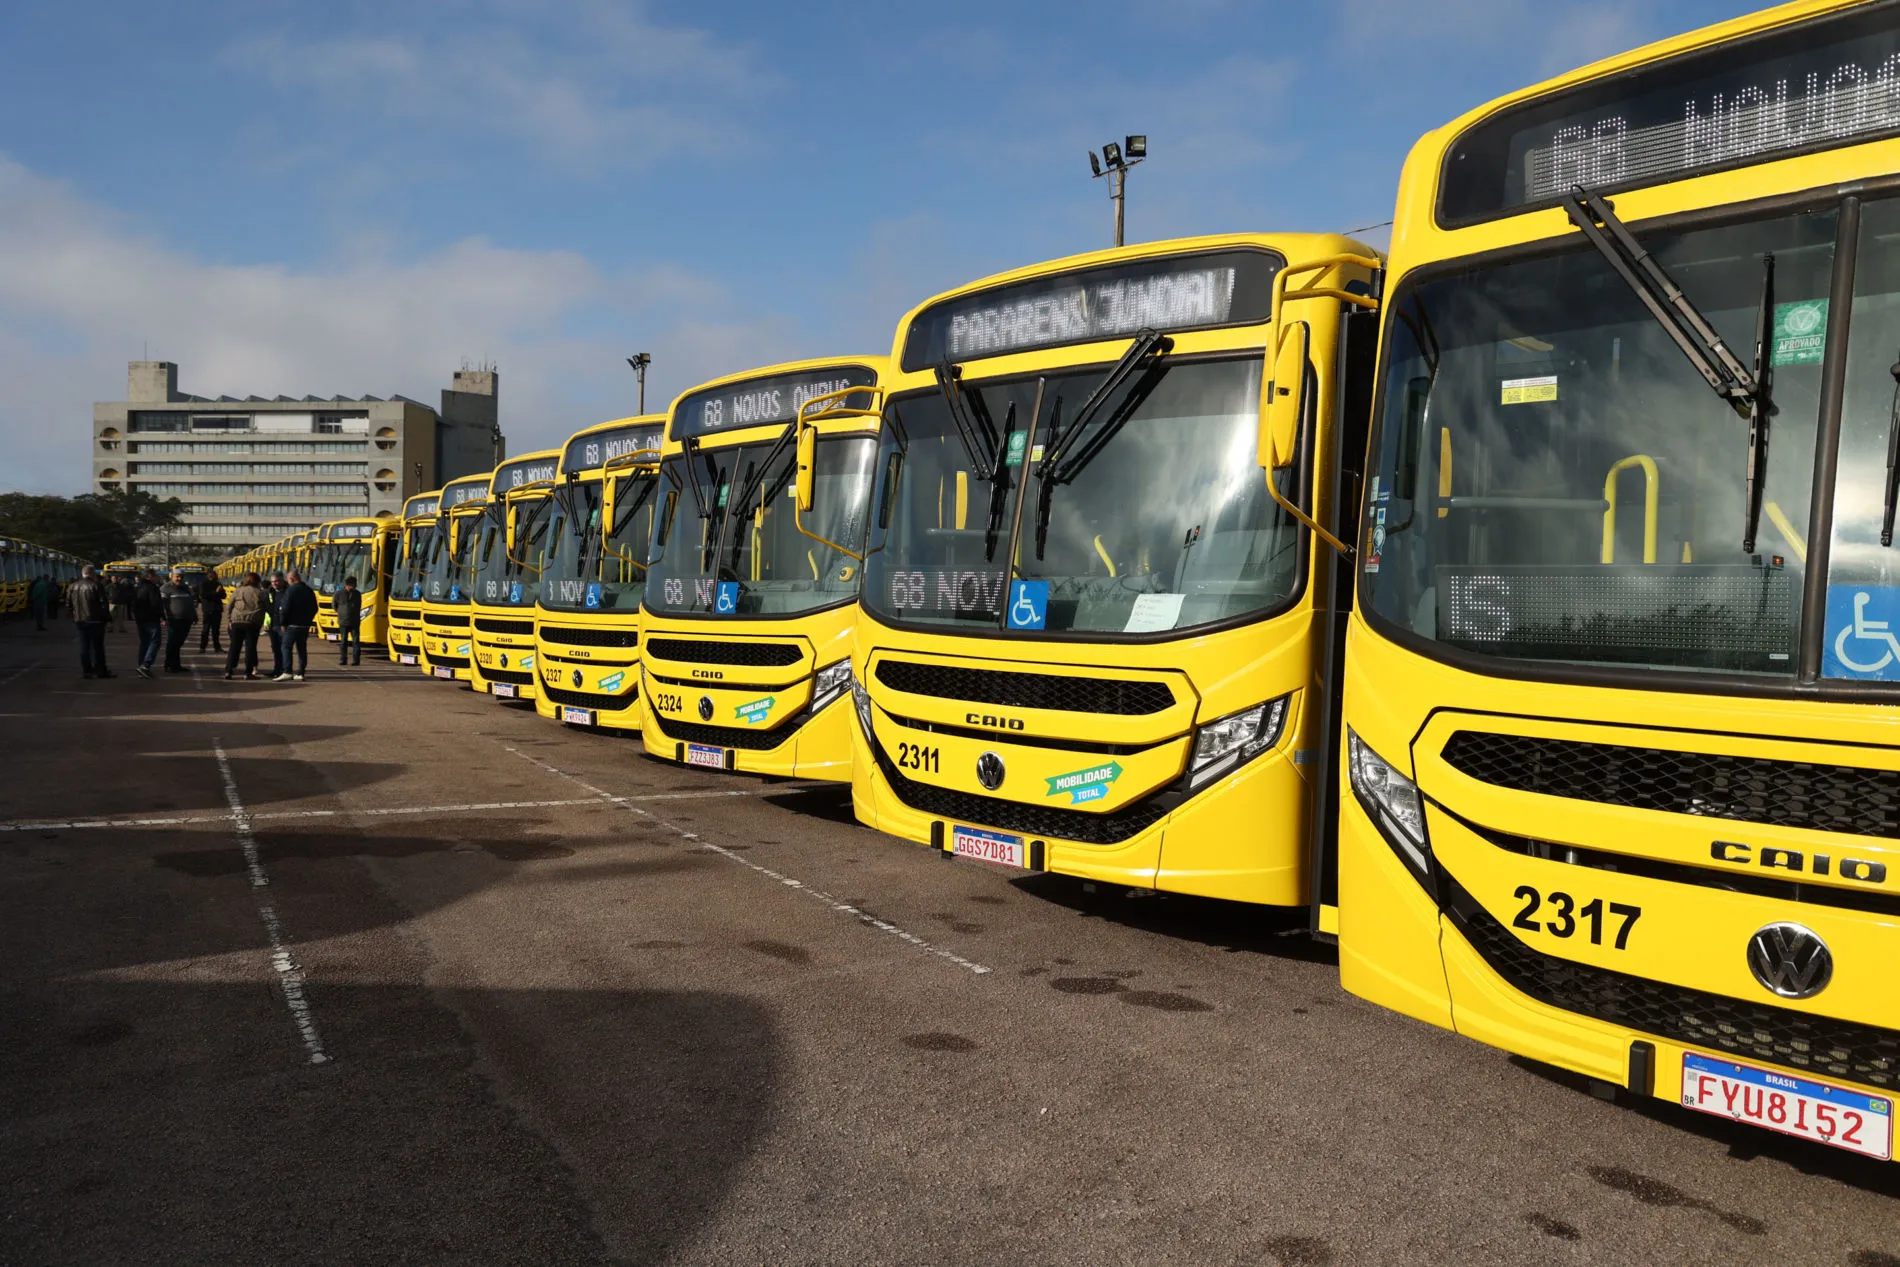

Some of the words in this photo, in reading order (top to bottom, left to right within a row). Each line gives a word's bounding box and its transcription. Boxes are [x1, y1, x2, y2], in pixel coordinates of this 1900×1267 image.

[1778, 336, 1821, 351] APROVADO
[704, 399, 723, 427] 68
[734, 390, 781, 423] NOVOS
[586, 444, 599, 465] 68
[512, 470, 523, 486] 68
[486, 580, 497, 598] 68
[664, 578, 683, 604] 68
[892, 571, 926, 609] 68
[937, 571, 1004, 611] NOV
[546, 668, 562, 683] 2327
[692, 670, 724, 679] CAIO
[657, 693, 683, 713] 2324
[965, 713, 1025, 731] CAIO
[898, 742, 940, 774] 2311
[1056, 767, 1113, 790] MOBILIDADE
[1077, 787, 1101, 800] TOTAL
[959, 836, 1014, 863] GGS7D81
[1710, 840, 1887, 883] CAIO
[1512, 885, 1642, 951] 2317
[1765, 1074, 1798, 1089] BRASIL
[1684, 1094, 1695, 1106] BR
[1698, 1075, 1863, 1145] FYU8I52
